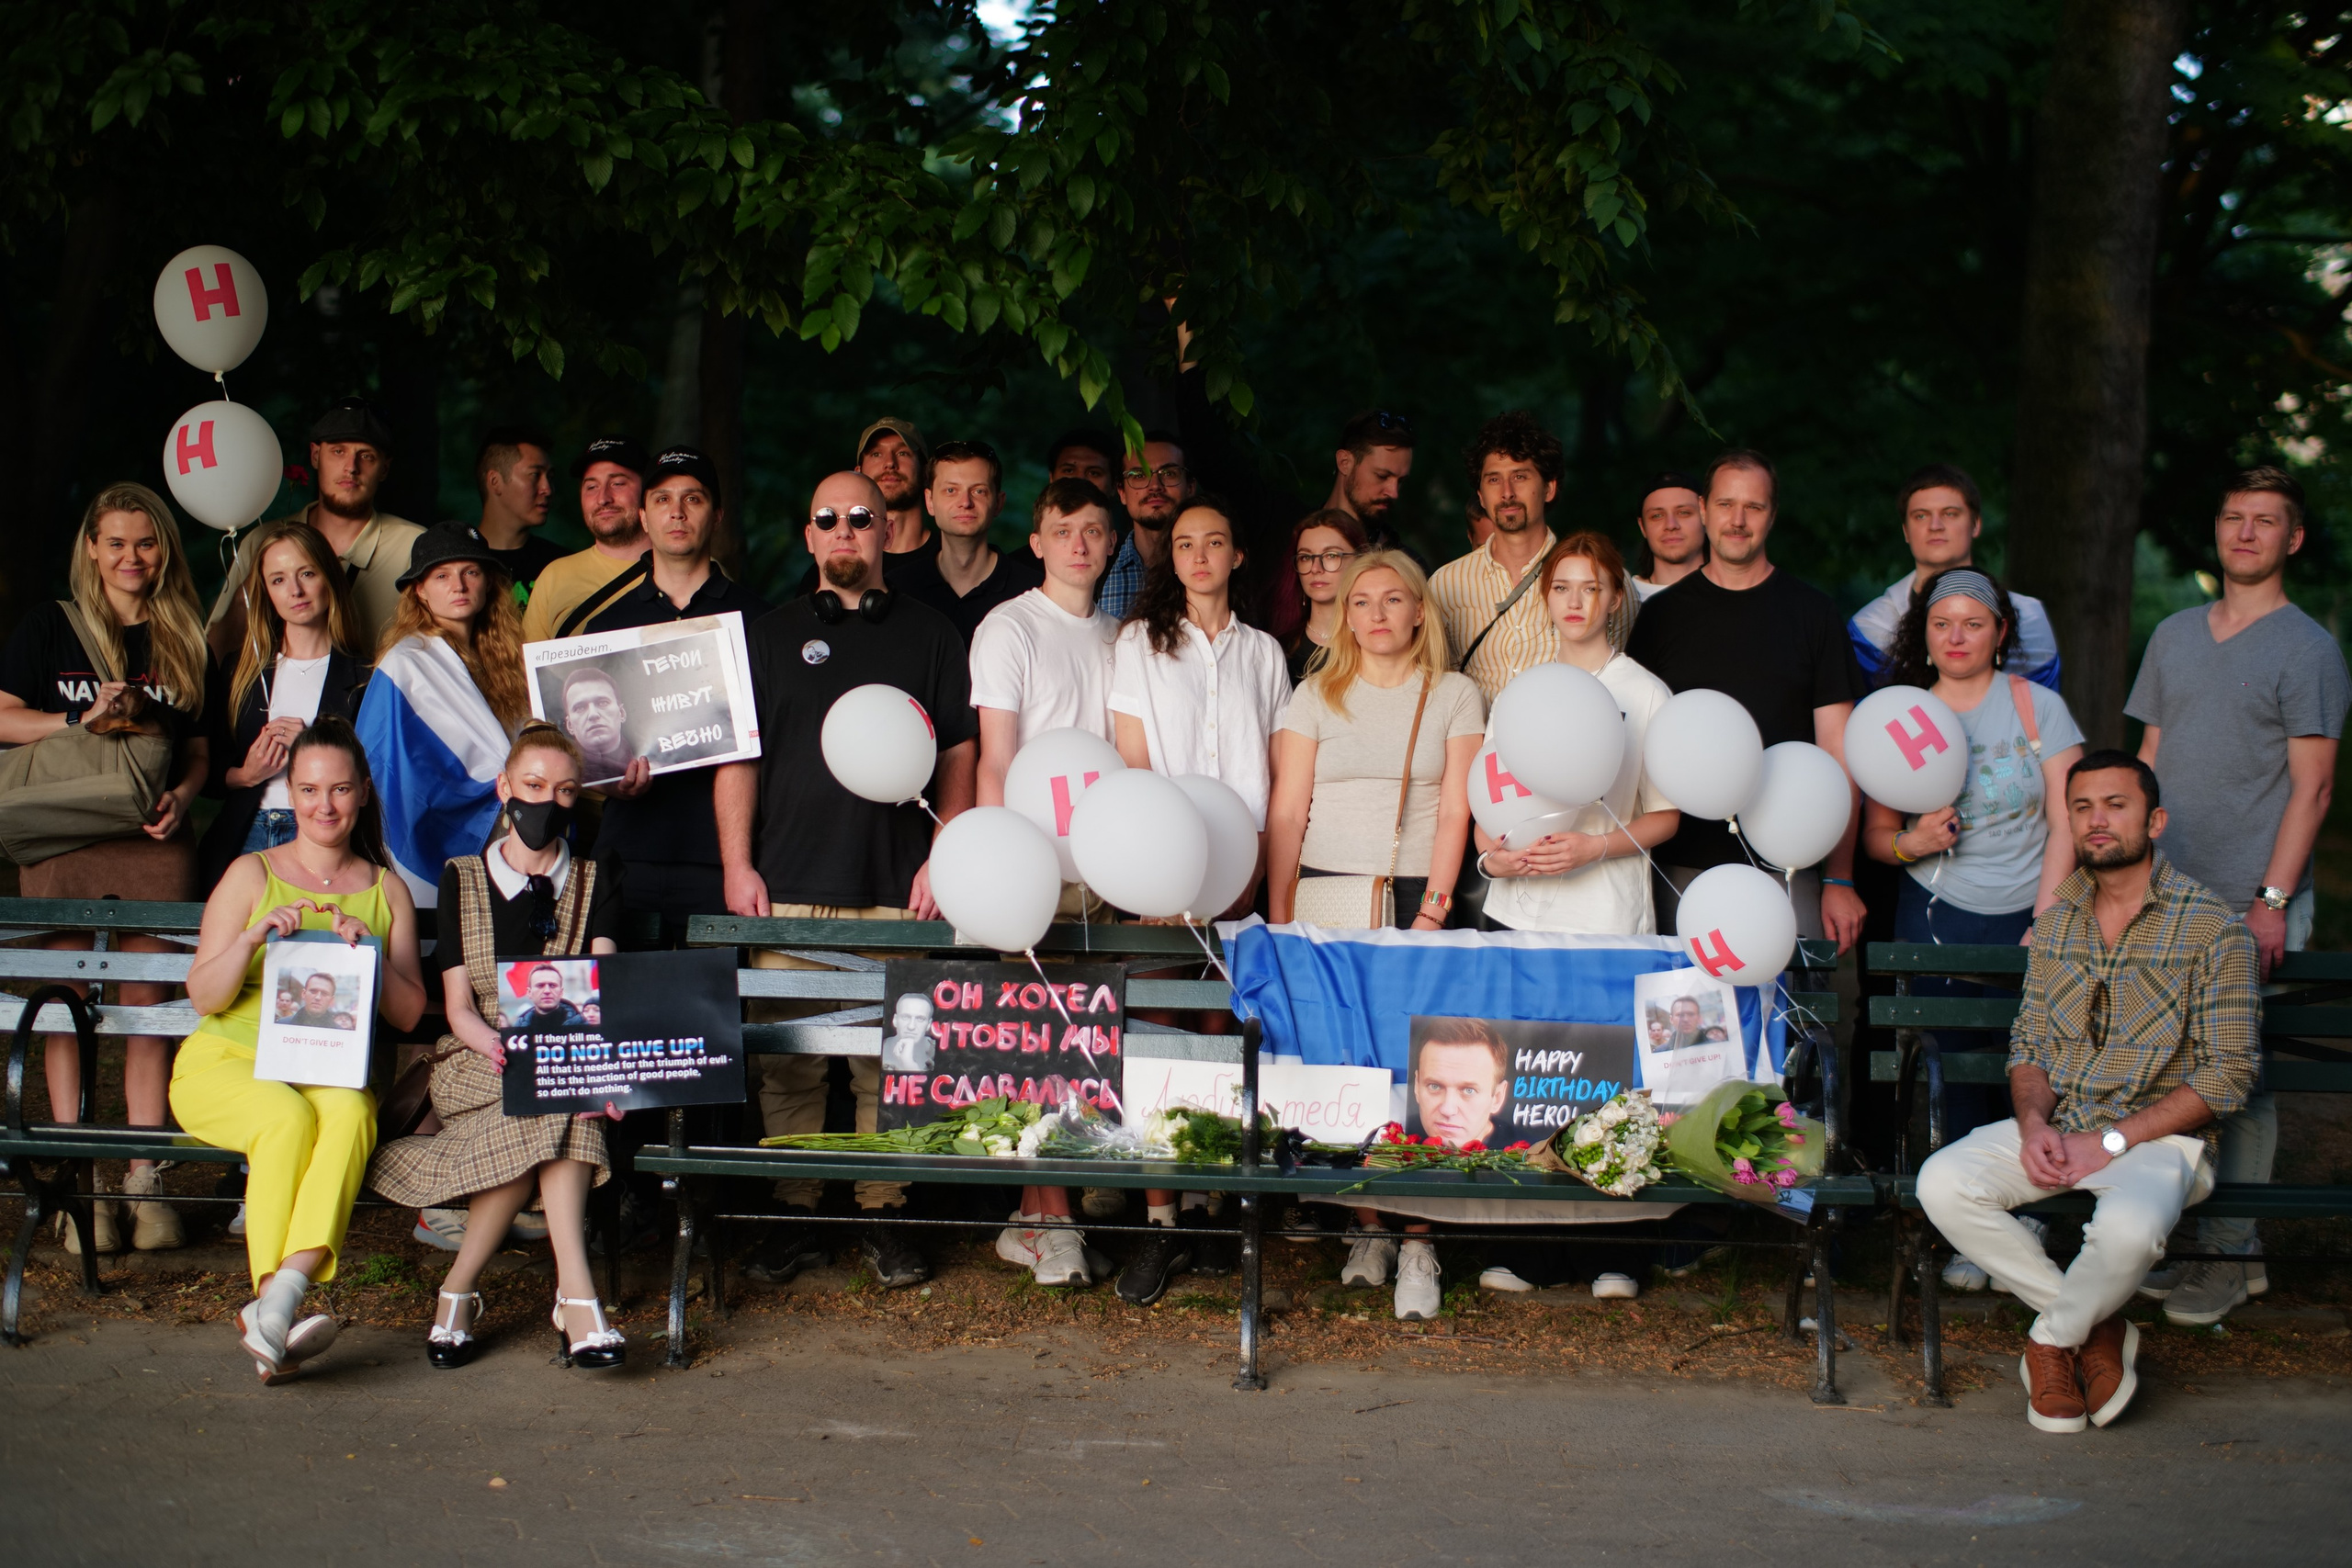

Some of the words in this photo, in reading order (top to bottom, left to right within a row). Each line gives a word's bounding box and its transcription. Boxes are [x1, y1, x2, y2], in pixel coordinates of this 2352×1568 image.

[642, 649, 702, 676] ГЕРОИ
[651, 685, 713, 714] ЖИВУТ
[658, 724, 723, 754] ВЕЧНО
[933, 980, 983, 1010] ОН
[995, 981, 1117, 1013] ХОТЕЛ
[283, 1036, 308, 1045] DON'T
[310, 1039, 328, 1047] GIVE
[330, 1040, 344, 1048] UP!
[535, 1033, 544, 1043] If
[545, 1033, 567, 1044] they
[570, 1032, 584, 1042] kill
[586, 1033, 604, 1042] me,
[536, 1045, 565, 1063] DO
[571, 1043, 613, 1061] NOT
[618, 1040, 665, 1058] GIVE
[669, 1037, 705, 1055] UP!
[930, 1021, 1052, 1052] ЧТОБЫ
[1059, 1023, 1120, 1056] МЫ
[537, 1065, 549, 1074] All
[551, 1064, 571, 1074] that
[573, 1064, 582, 1073] is
[584, 1061, 620, 1072] needed
[622, 1060, 636, 1069] for
[638, 1058, 655, 1067] the
[657, 1056, 695, 1067] triumph
[696, 1055, 707, 1065] of
[708, 1055, 727, 1064] evil
[1515, 1047, 1583, 1074] HAPPY
[1689, 1056, 1706, 1065] GIVE
[537, 1077, 556, 1086] this
[558, 1076, 566, 1085] is
[568, 1075, 585, 1084] the
[587, 1073, 626, 1084] inaction
[628, 1071, 638, 1080] of
[639, 1069, 663, 1081] good
[665, 1067, 701, 1079] people,
[1513, 1076, 1621, 1102] BIRTHDAY
[537, 1089, 548, 1098] so
[550, 1087, 576, 1097] don't
[578, 1086, 591, 1095] do
[593, 1084, 633, 1094] nothing.
[883, 1074, 928, 1106] НЕ
[1282, 1083, 1366, 1128] тебя
[1512, 1103, 1578, 1128] HERO!
